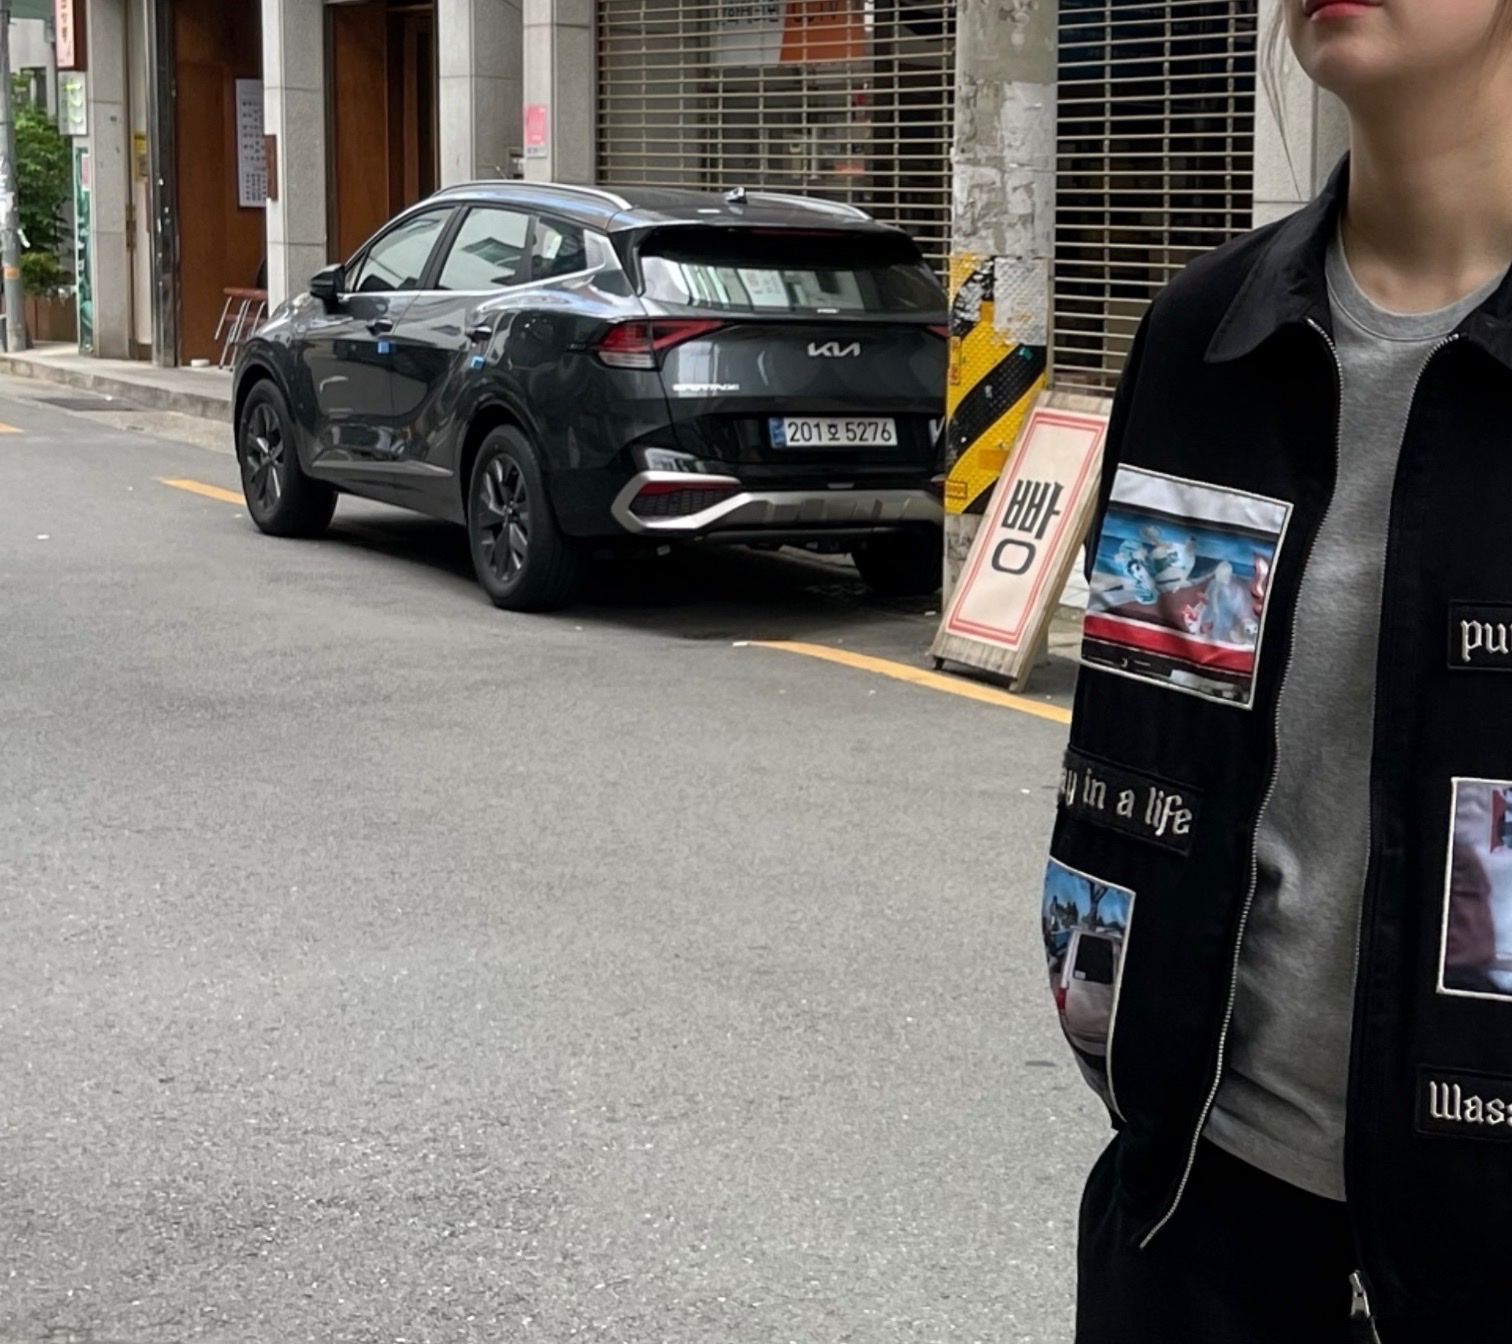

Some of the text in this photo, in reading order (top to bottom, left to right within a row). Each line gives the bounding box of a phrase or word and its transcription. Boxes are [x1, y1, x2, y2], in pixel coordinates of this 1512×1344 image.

[845, 421, 892, 442] 5276
[991, 479, 1064, 577] 빵
[1082, 768, 1107, 810] in
[1117, 788, 1135, 819] a
[1144, 786, 1193, 837] life
